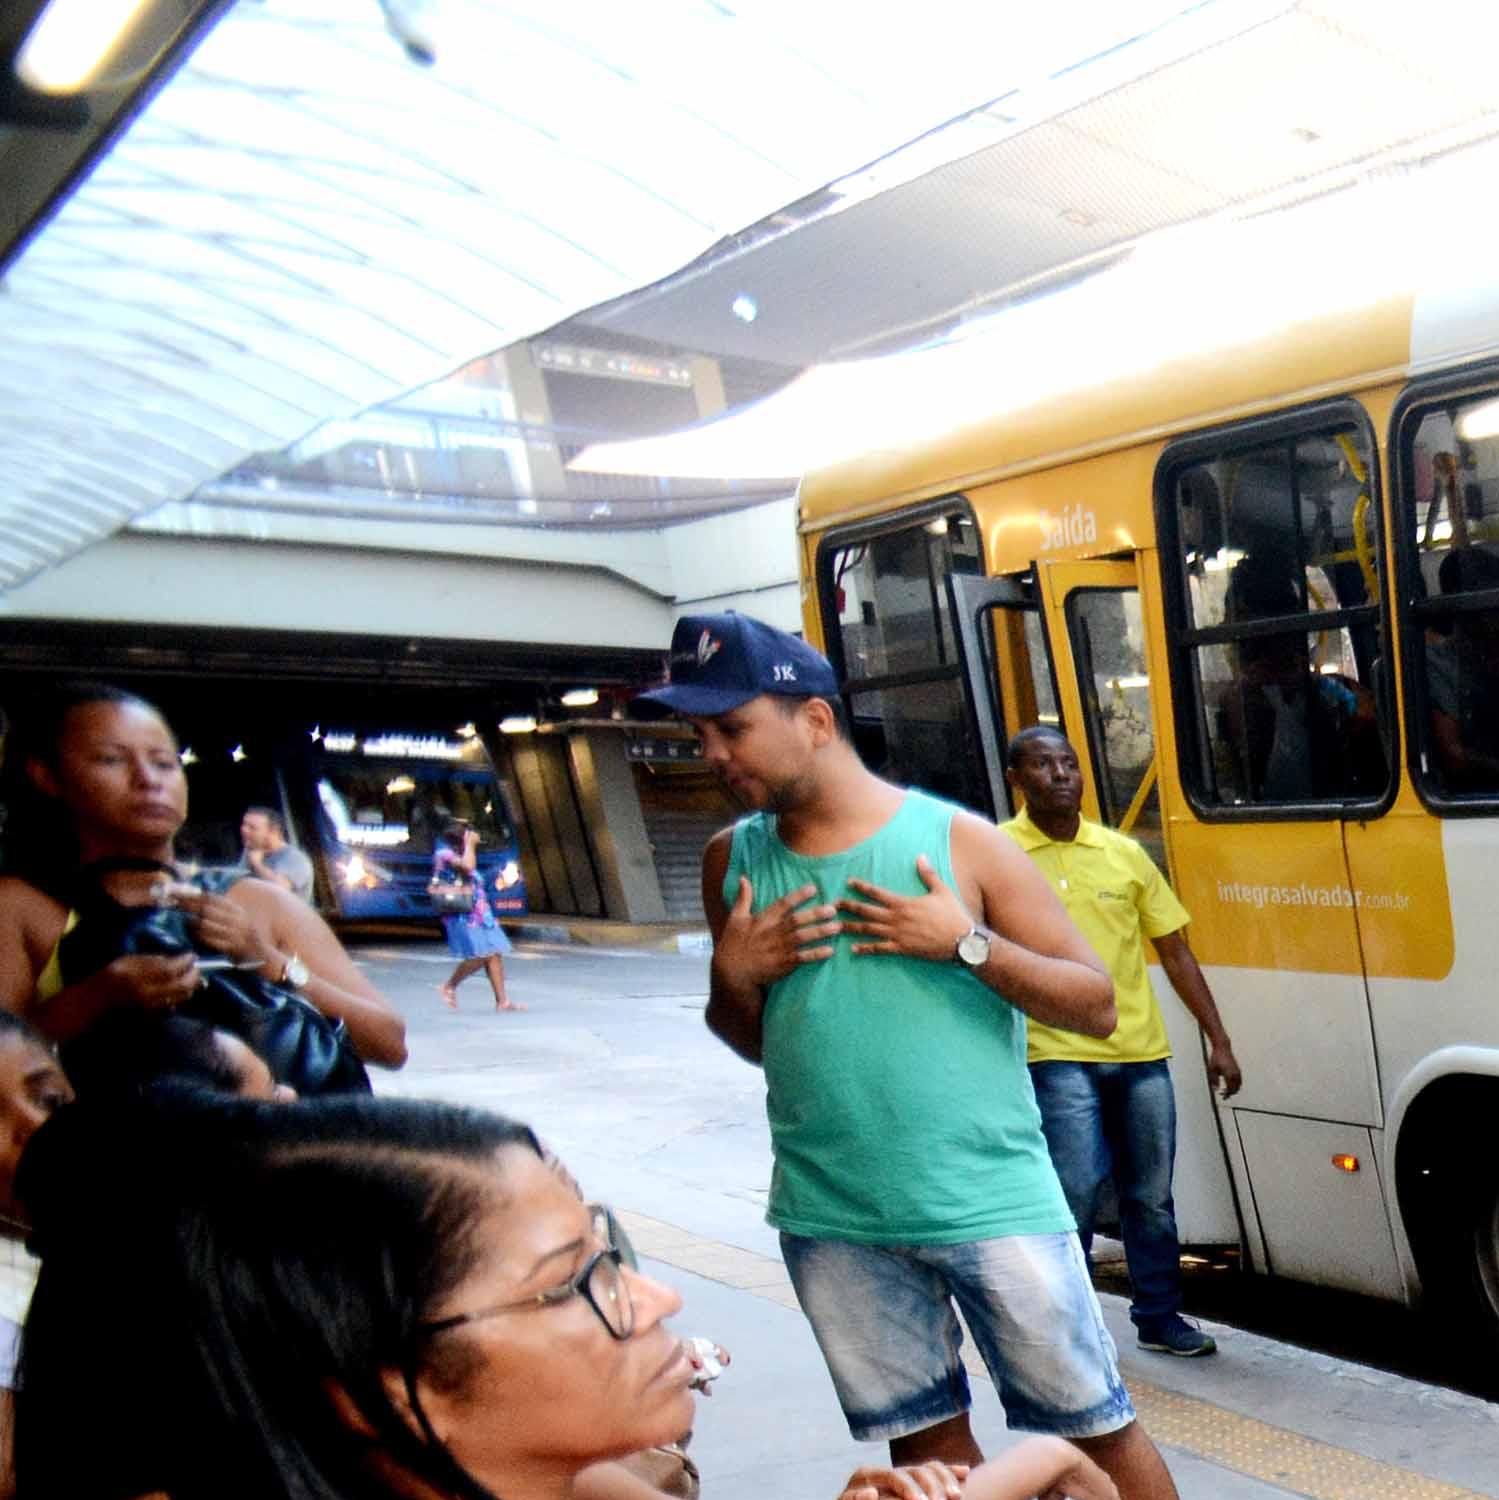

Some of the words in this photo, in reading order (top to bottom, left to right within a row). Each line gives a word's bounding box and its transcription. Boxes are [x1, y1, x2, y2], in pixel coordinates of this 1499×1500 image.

[1040, 503, 1097, 550] Saída
[772, 662, 797, 681] JK
[1217, 880, 1410, 909] integrasalvador.com.br
